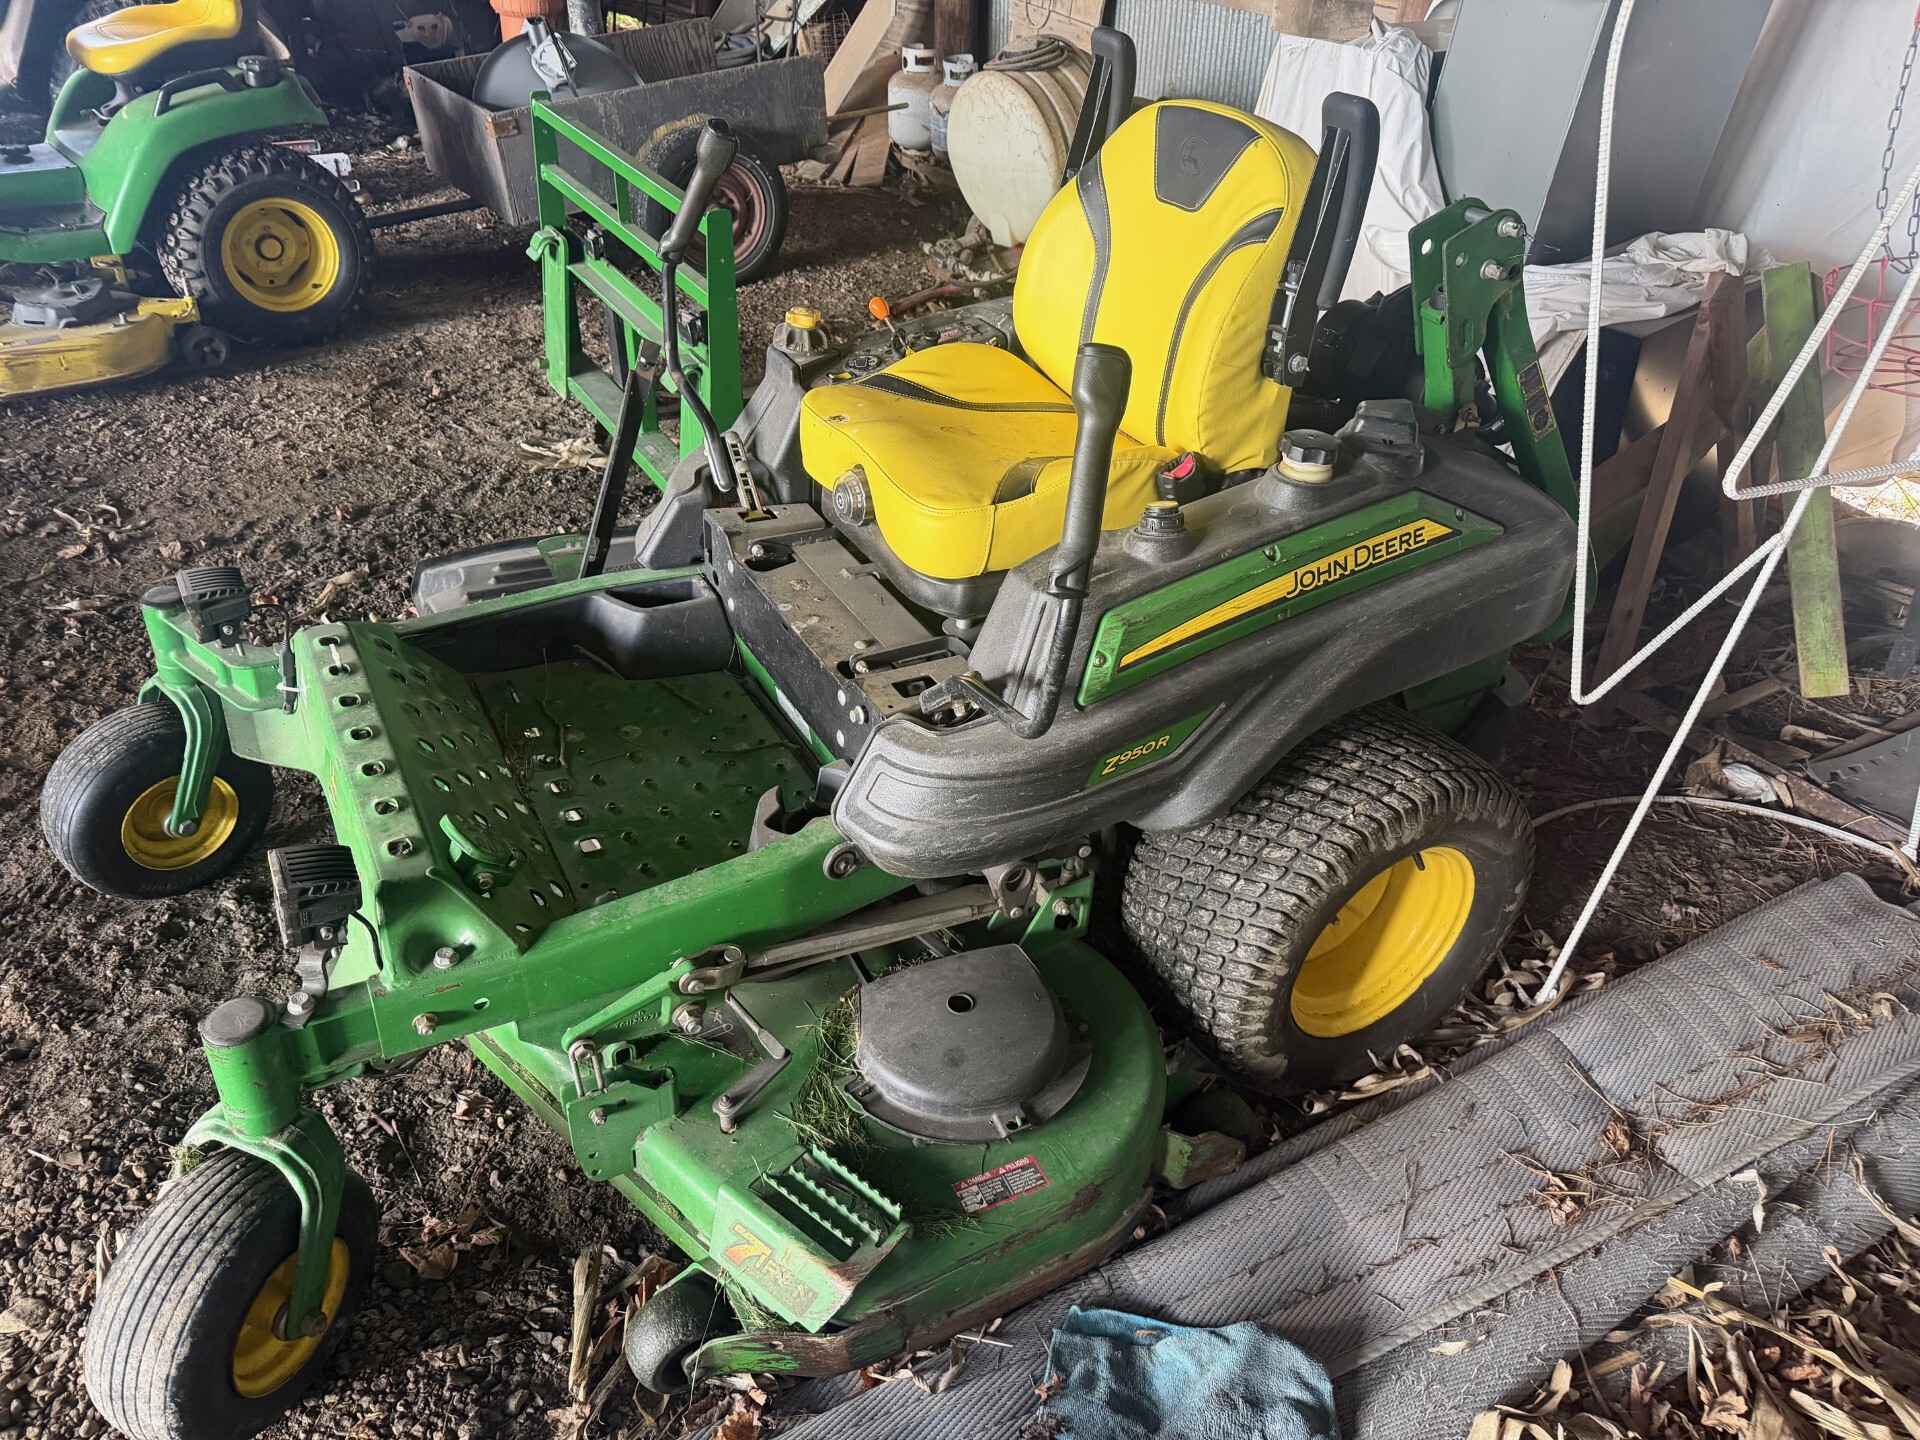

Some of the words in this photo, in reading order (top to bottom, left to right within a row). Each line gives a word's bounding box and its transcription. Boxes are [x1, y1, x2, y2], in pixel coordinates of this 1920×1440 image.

[1286, 556, 1348, 597] JOHN
[1354, 526, 1427, 570] DEERE
[1101, 734, 1170, 776] Z950R
[967, 1171, 992, 1185] DANGER
[1005, 1157, 1030, 1171] PELIGRO
